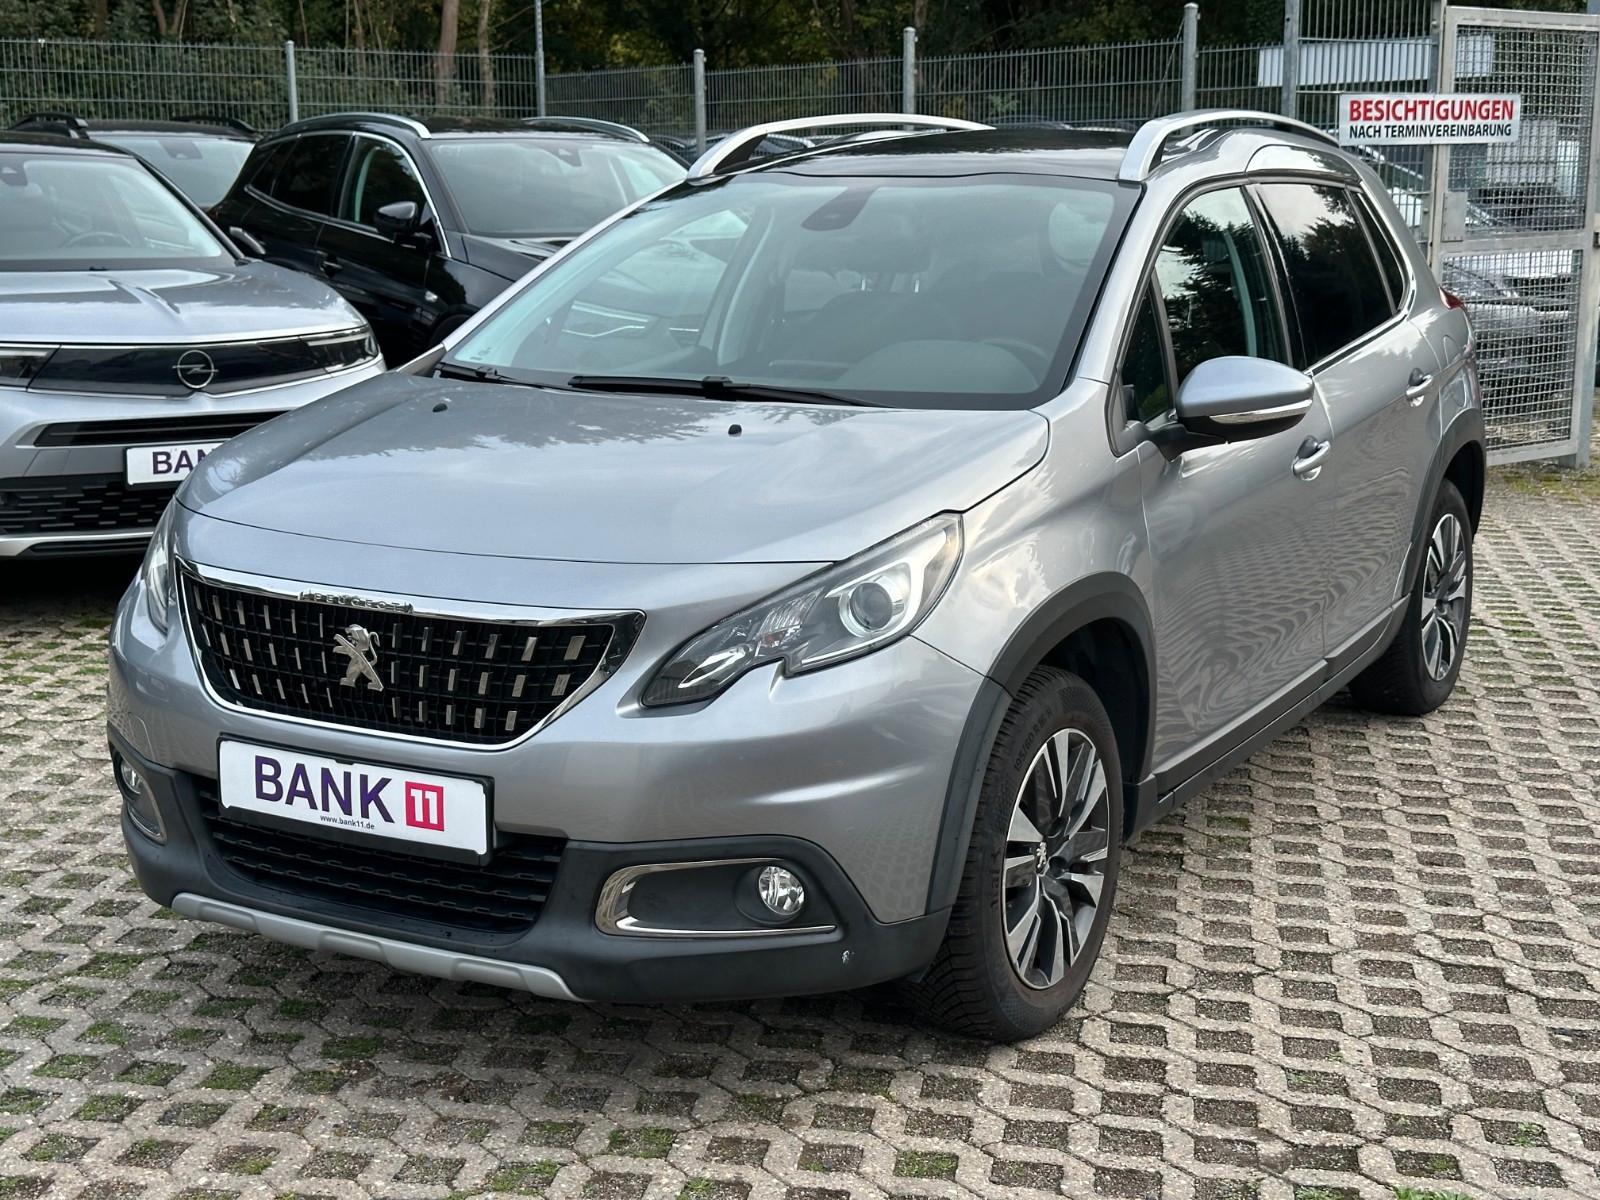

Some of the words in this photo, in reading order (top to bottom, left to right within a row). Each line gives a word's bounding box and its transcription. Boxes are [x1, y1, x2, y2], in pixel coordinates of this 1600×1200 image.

[1349, 99, 1514, 122] BESICHTIGUNGEN
[1349, 124, 1381, 139] NACH
[1384, 123, 1512, 138] TERMINVEREINBARUNG
[254, 754, 396, 824] BANK
[410, 787, 439, 826] 11
[319, 814, 376, 831] www.bank11.de
